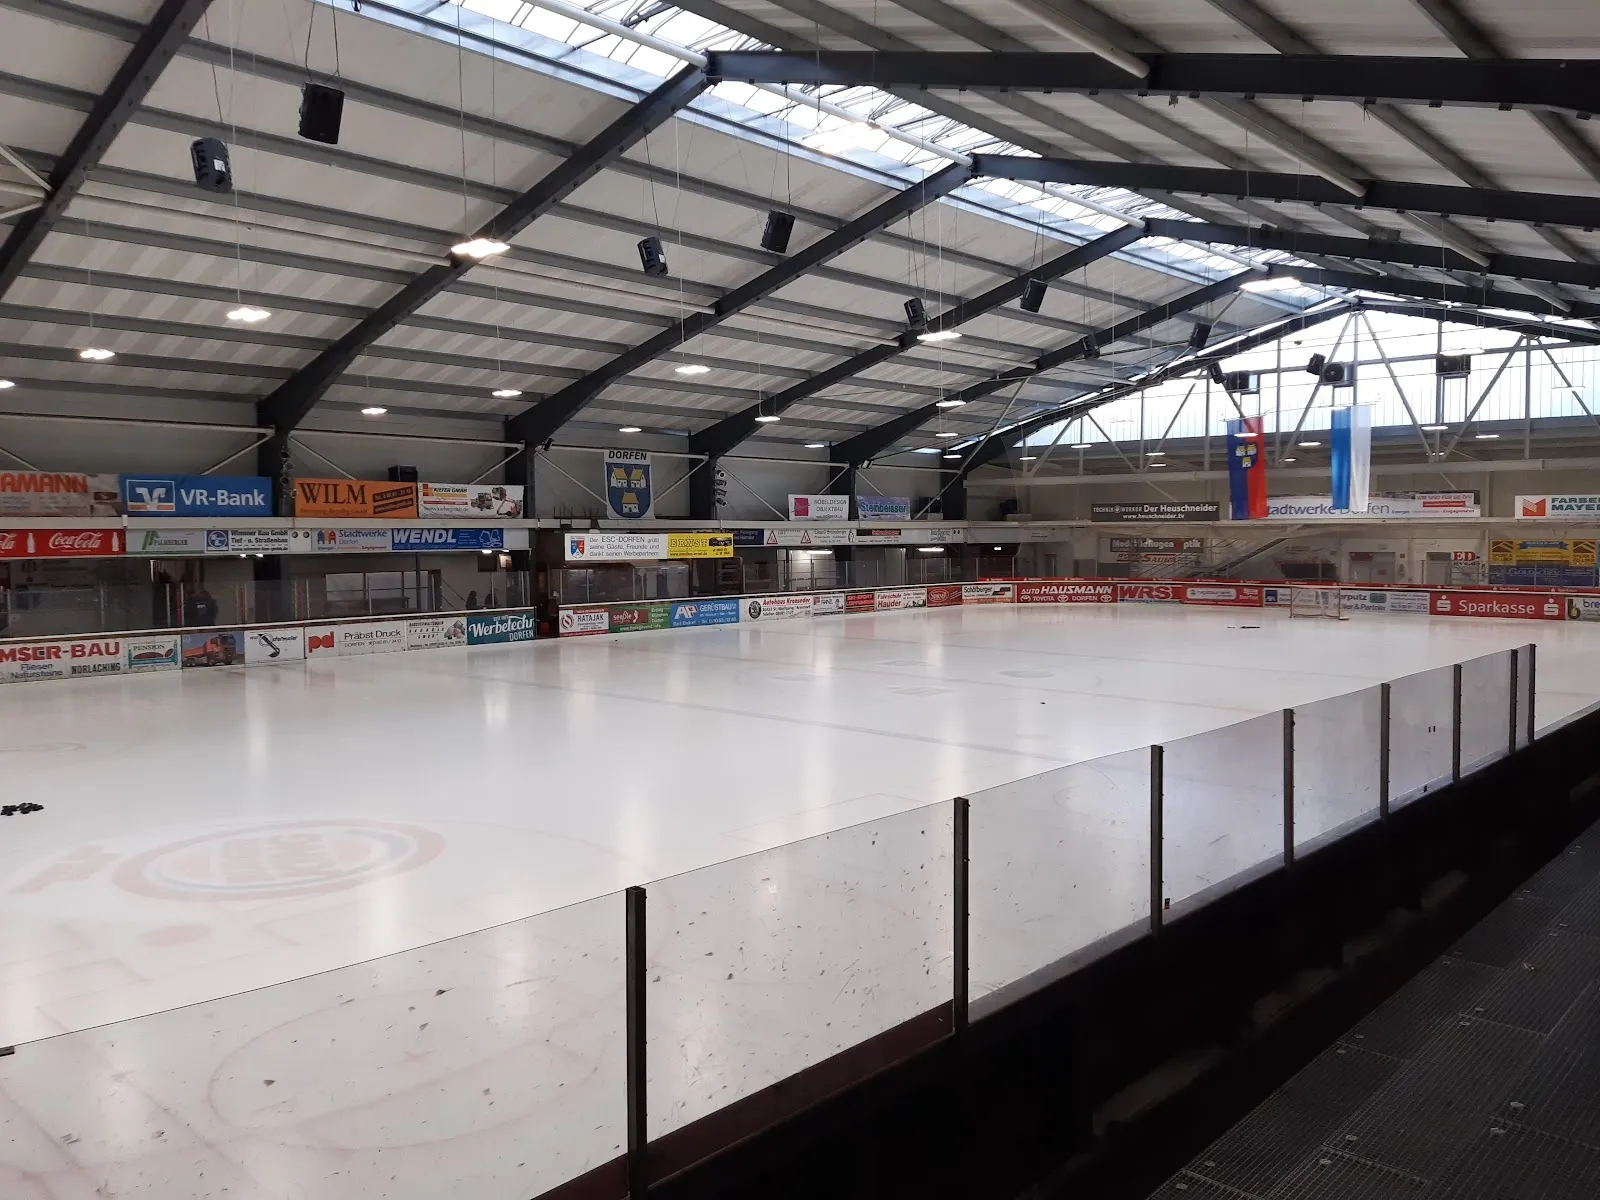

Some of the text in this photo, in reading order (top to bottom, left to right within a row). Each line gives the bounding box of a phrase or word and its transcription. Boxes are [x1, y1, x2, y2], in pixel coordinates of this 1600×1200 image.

[608, 450, 648, 460] DORFEN
[180, 488, 266, 506] VR-Bank
[298, 483, 368, 504] WILM
[1143, 504, 1159, 513] Der
[1160, 503, 1218, 513] Heuschneider
[1266, 503, 1337, 515] tadtwerke
[338, 529, 388, 538] Stadtwerke
[393, 528, 457, 544] WENDL
[48, 532, 104, 550] Coca-Cola
[670, 538, 708, 548] ERNST
[1041, 585, 1113, 594] HAUSMANN
[1118, 585, 1173, 600] WRS
[877, 592, 902, 600] Fahrschule
[700, 602, 732, 612] GERÜSTBAU
[763, 598, 786, 606] Autohaus
[877, 599, 902, 608] Hauder
[1459, 599, 1536, 614] Sparkasse
[344, 632, 373, 641] Präbst
[376, 630, 401, 639] Druck
[509, 629, 535, 641] DORFEN
[0, 641, 120, 663] MSER-BAU
[133, 643, 165, 651] PENSION
[20, 663, 53, 671] Fliesen
[10, 670, 64, 680] Natursteine
